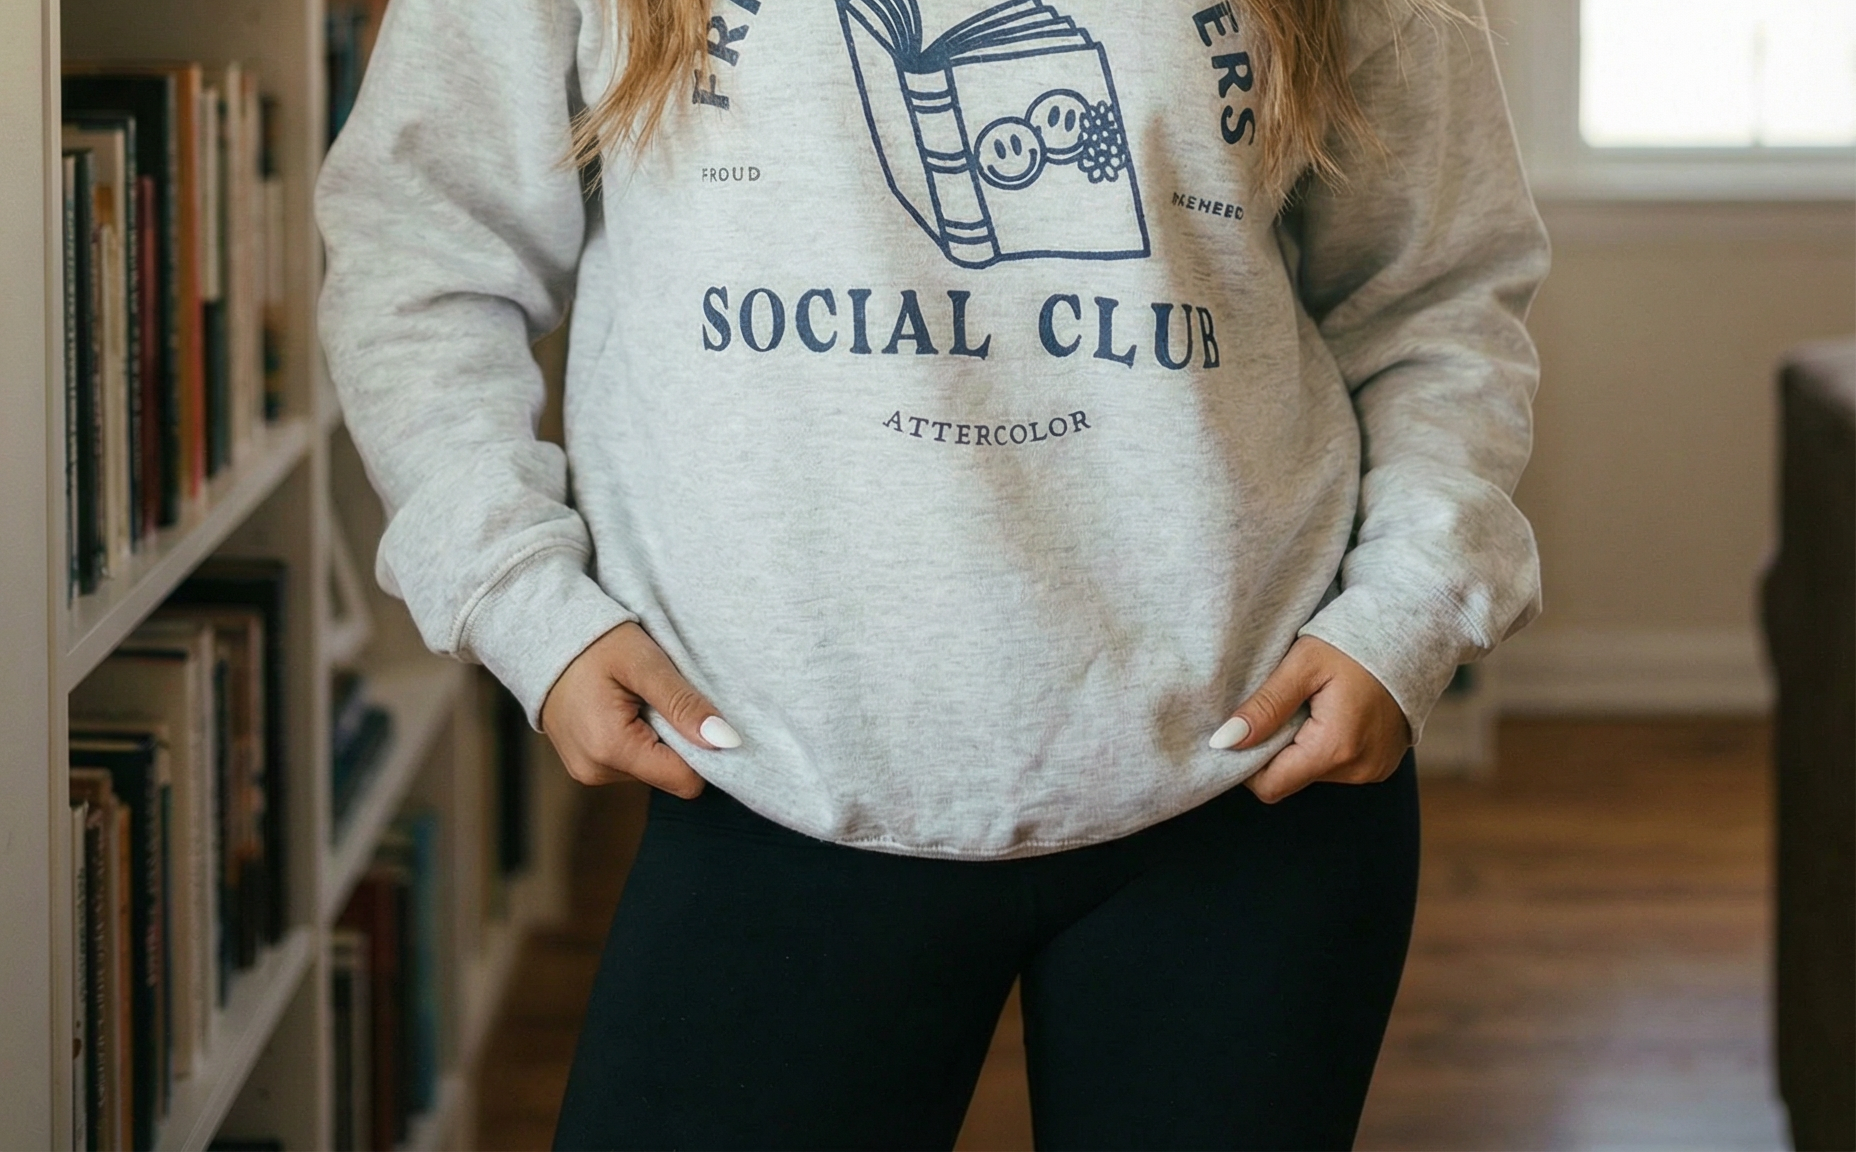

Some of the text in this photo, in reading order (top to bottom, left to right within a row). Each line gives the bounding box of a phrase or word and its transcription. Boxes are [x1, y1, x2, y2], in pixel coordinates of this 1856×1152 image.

[702, 286, 1220, 371] SOCIAL CLUB
[882, 410, 1091, 446] ATTERCOLOR
